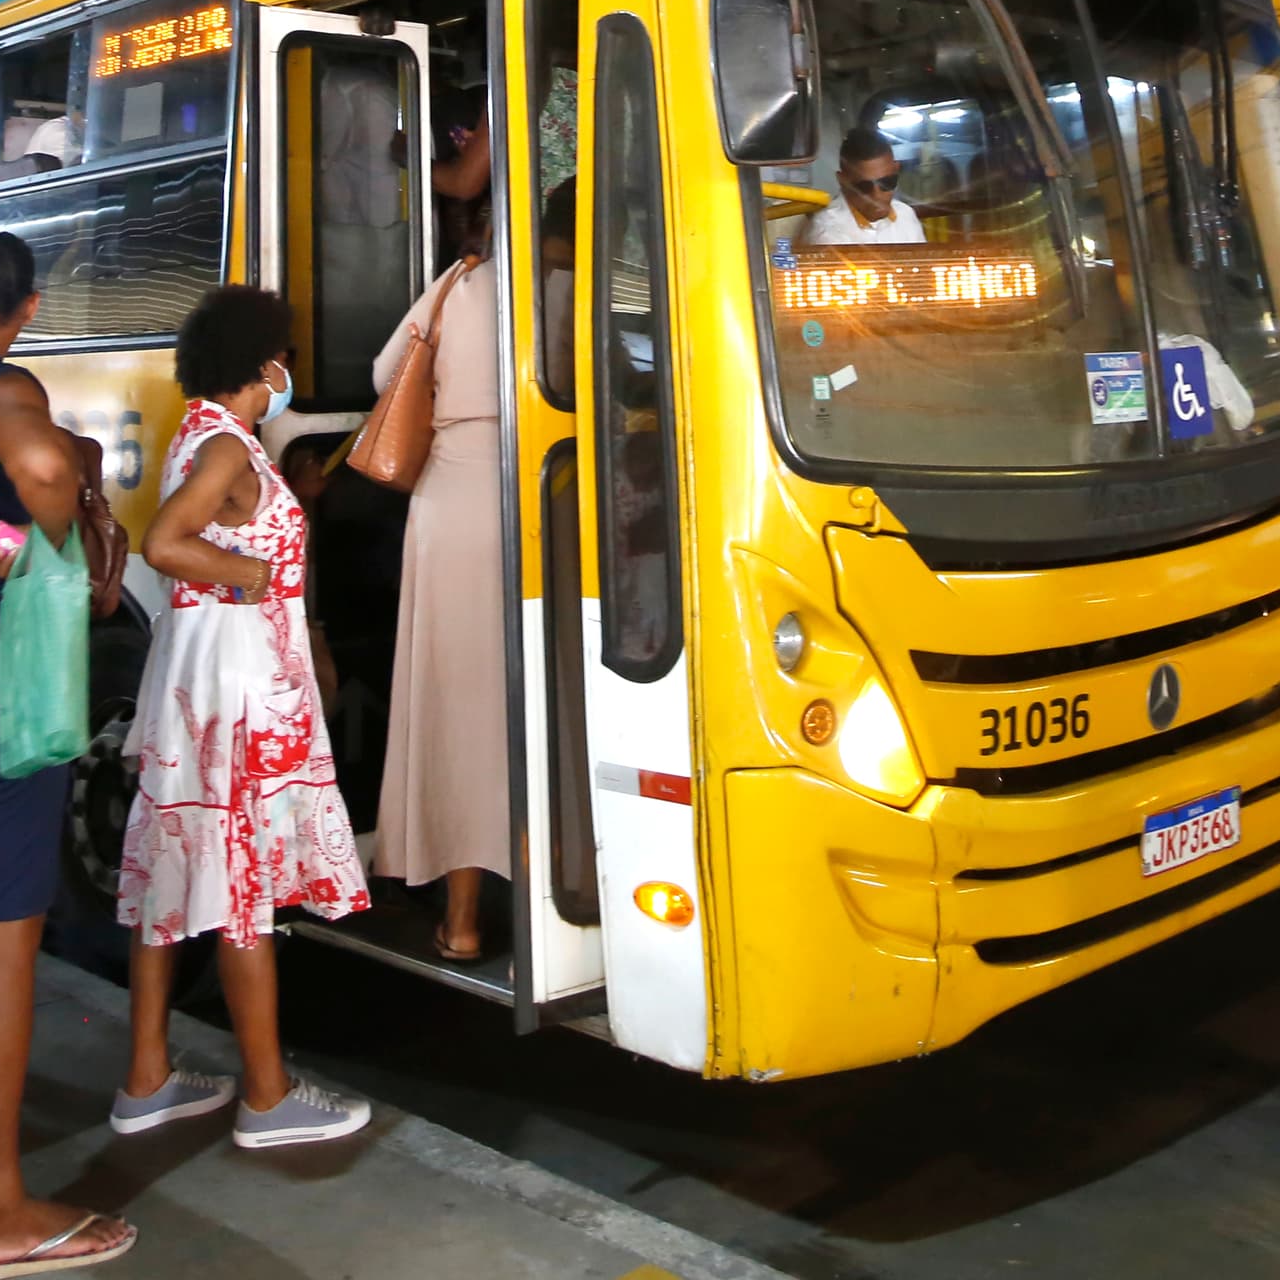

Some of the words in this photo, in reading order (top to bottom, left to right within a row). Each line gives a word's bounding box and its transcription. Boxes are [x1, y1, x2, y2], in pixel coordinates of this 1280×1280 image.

[783, 268, 881, 308] HOSP
[979, 693, 1090, 757] 31036
[1152, 807, 1235, 867] JKP3E68
